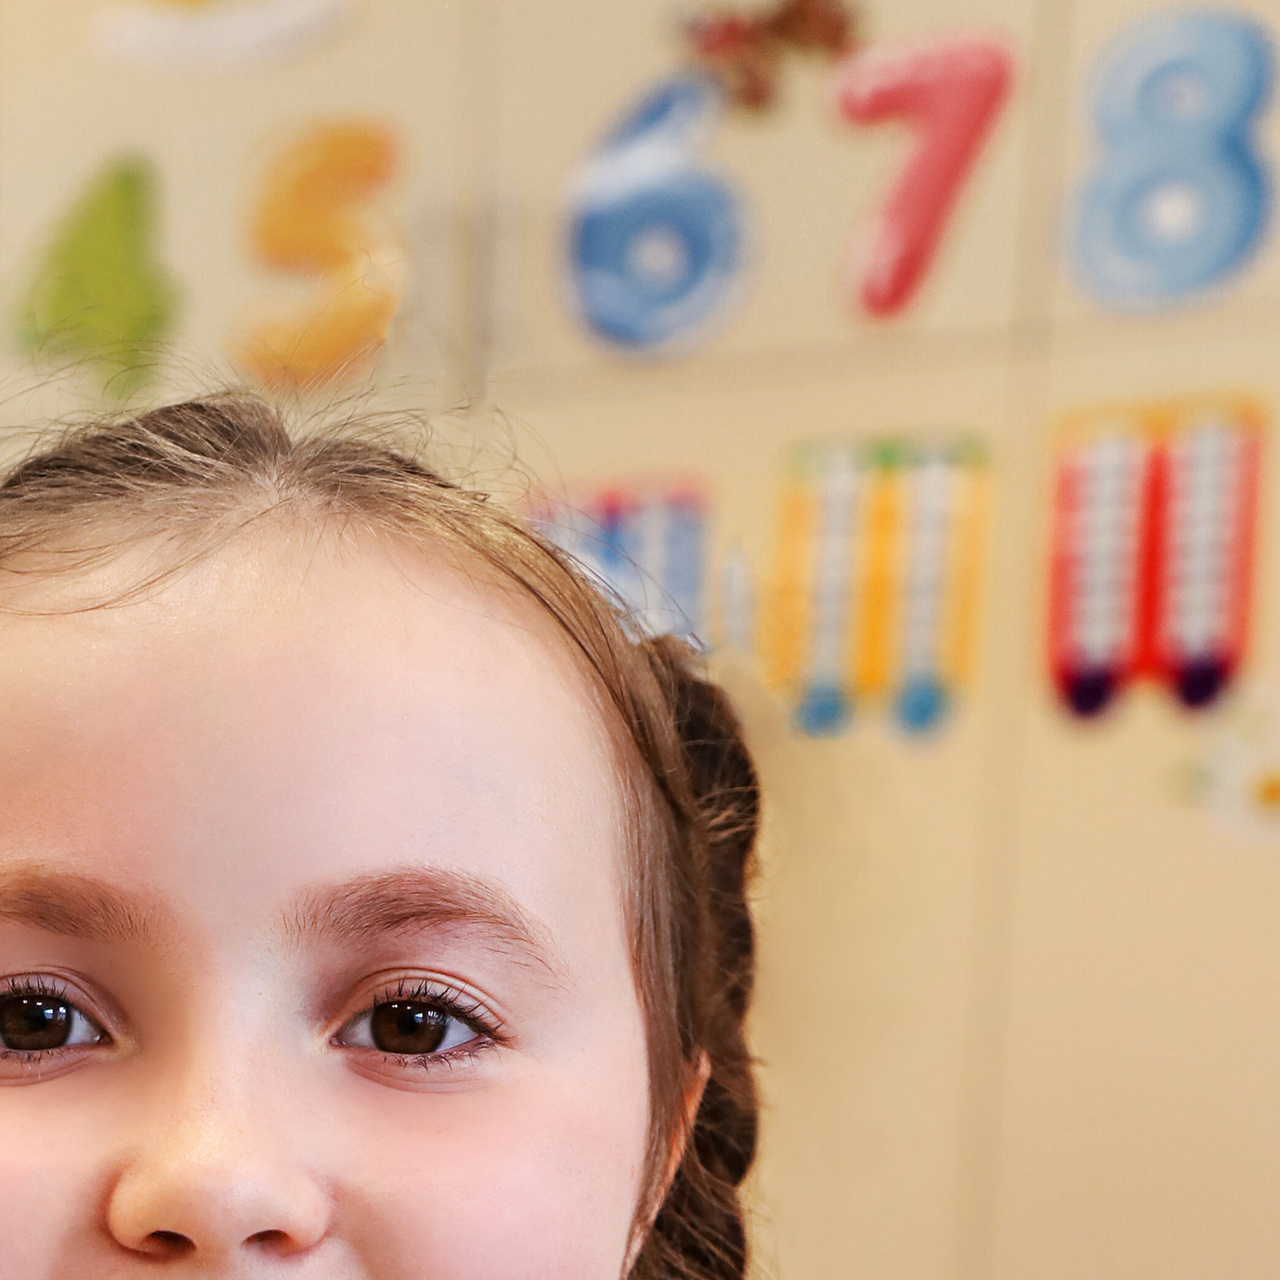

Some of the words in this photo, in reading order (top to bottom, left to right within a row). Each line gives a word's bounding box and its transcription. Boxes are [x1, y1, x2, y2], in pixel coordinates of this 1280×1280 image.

[8, 148, 182, 405] 4
[238, 118, 404, 390] 5
[566, 72, 742, 350] 6
[836, 38, 1016, 318] 7
[1068, 10, 1274, 315] 8
